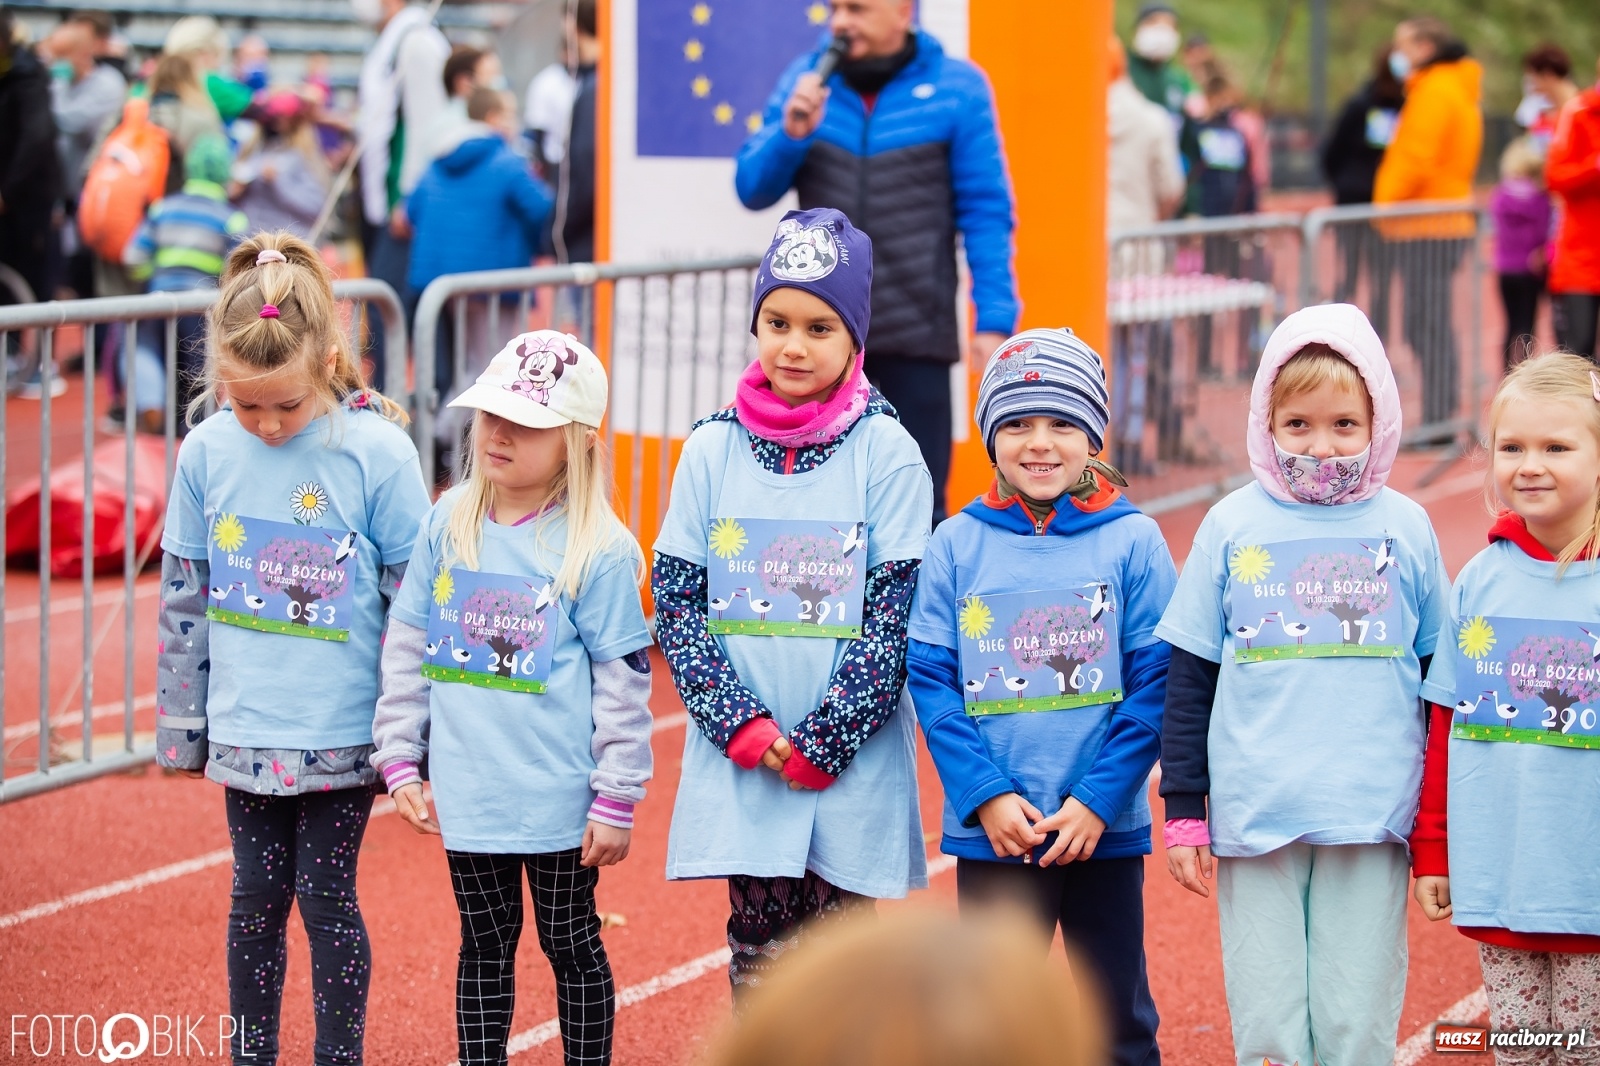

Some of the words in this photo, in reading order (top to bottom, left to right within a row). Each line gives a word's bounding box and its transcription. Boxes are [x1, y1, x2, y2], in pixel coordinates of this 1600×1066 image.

[227, 553, 253, 570] BIEG
[259, 560, 284, 575] DLA
[728, 560, 756, 574] BIEG
[764, 560, 789, 574] DLA
[1254, 582, 1286, 598] BIEG
[1296, 581, 1323, 595] DLA
[286, 600, 336, 625] 053
[440, 607, 458, 623] BIEG
[464, 611, 486, 626] DLA
[797, 600, 846, 626] 291
[978, 638, 1005, 653] BIEG
[1013, 635, 1040, 650] DLA
[1338, 619, 1387, 646] 173
[487, 650, 536, 676] 246
[1476, 660, 1503, 676] BIEG
[1511, 662, 1537, 678] DLA
[1053, 664, 1104, 693] 169
[1541, 706, 1597, 734] 290
